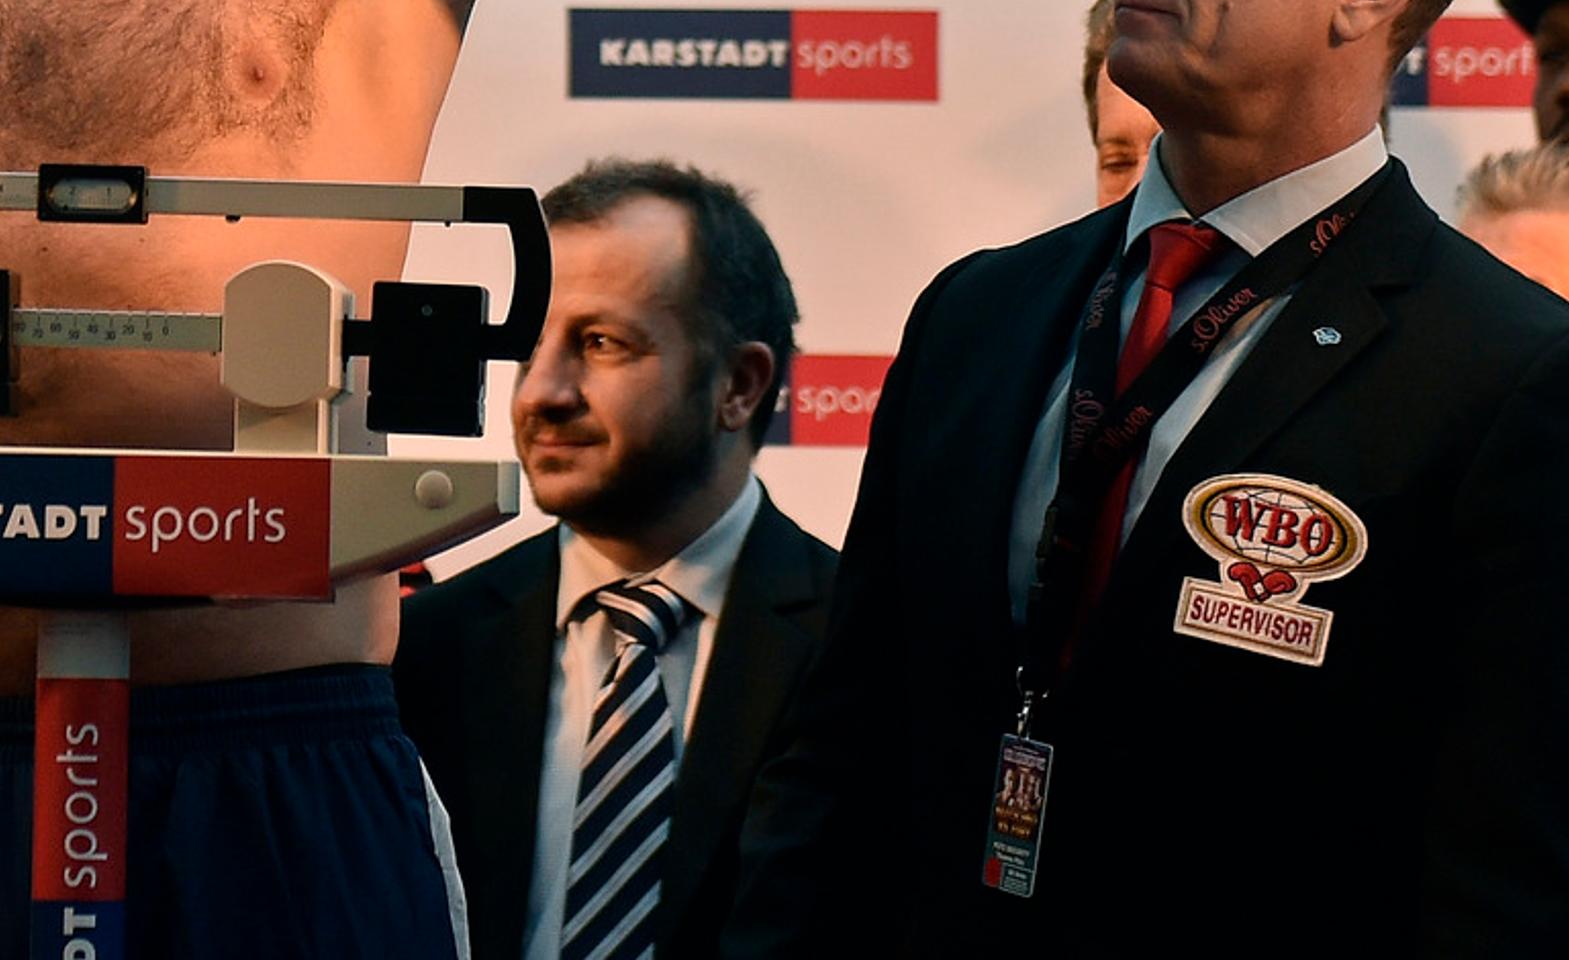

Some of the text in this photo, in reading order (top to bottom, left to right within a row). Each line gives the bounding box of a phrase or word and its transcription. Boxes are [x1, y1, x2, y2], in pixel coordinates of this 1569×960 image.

[599, 35, 914, 76] KARSTADT sports
[1434, 40, 1535, 83] sport
[125, 497, 286, 553] sports
[1222, 494, 1335, 557] WBO
[1189, 594, 1314, 646] SUPERVISOR
[56, 723, 109, 889] sports
